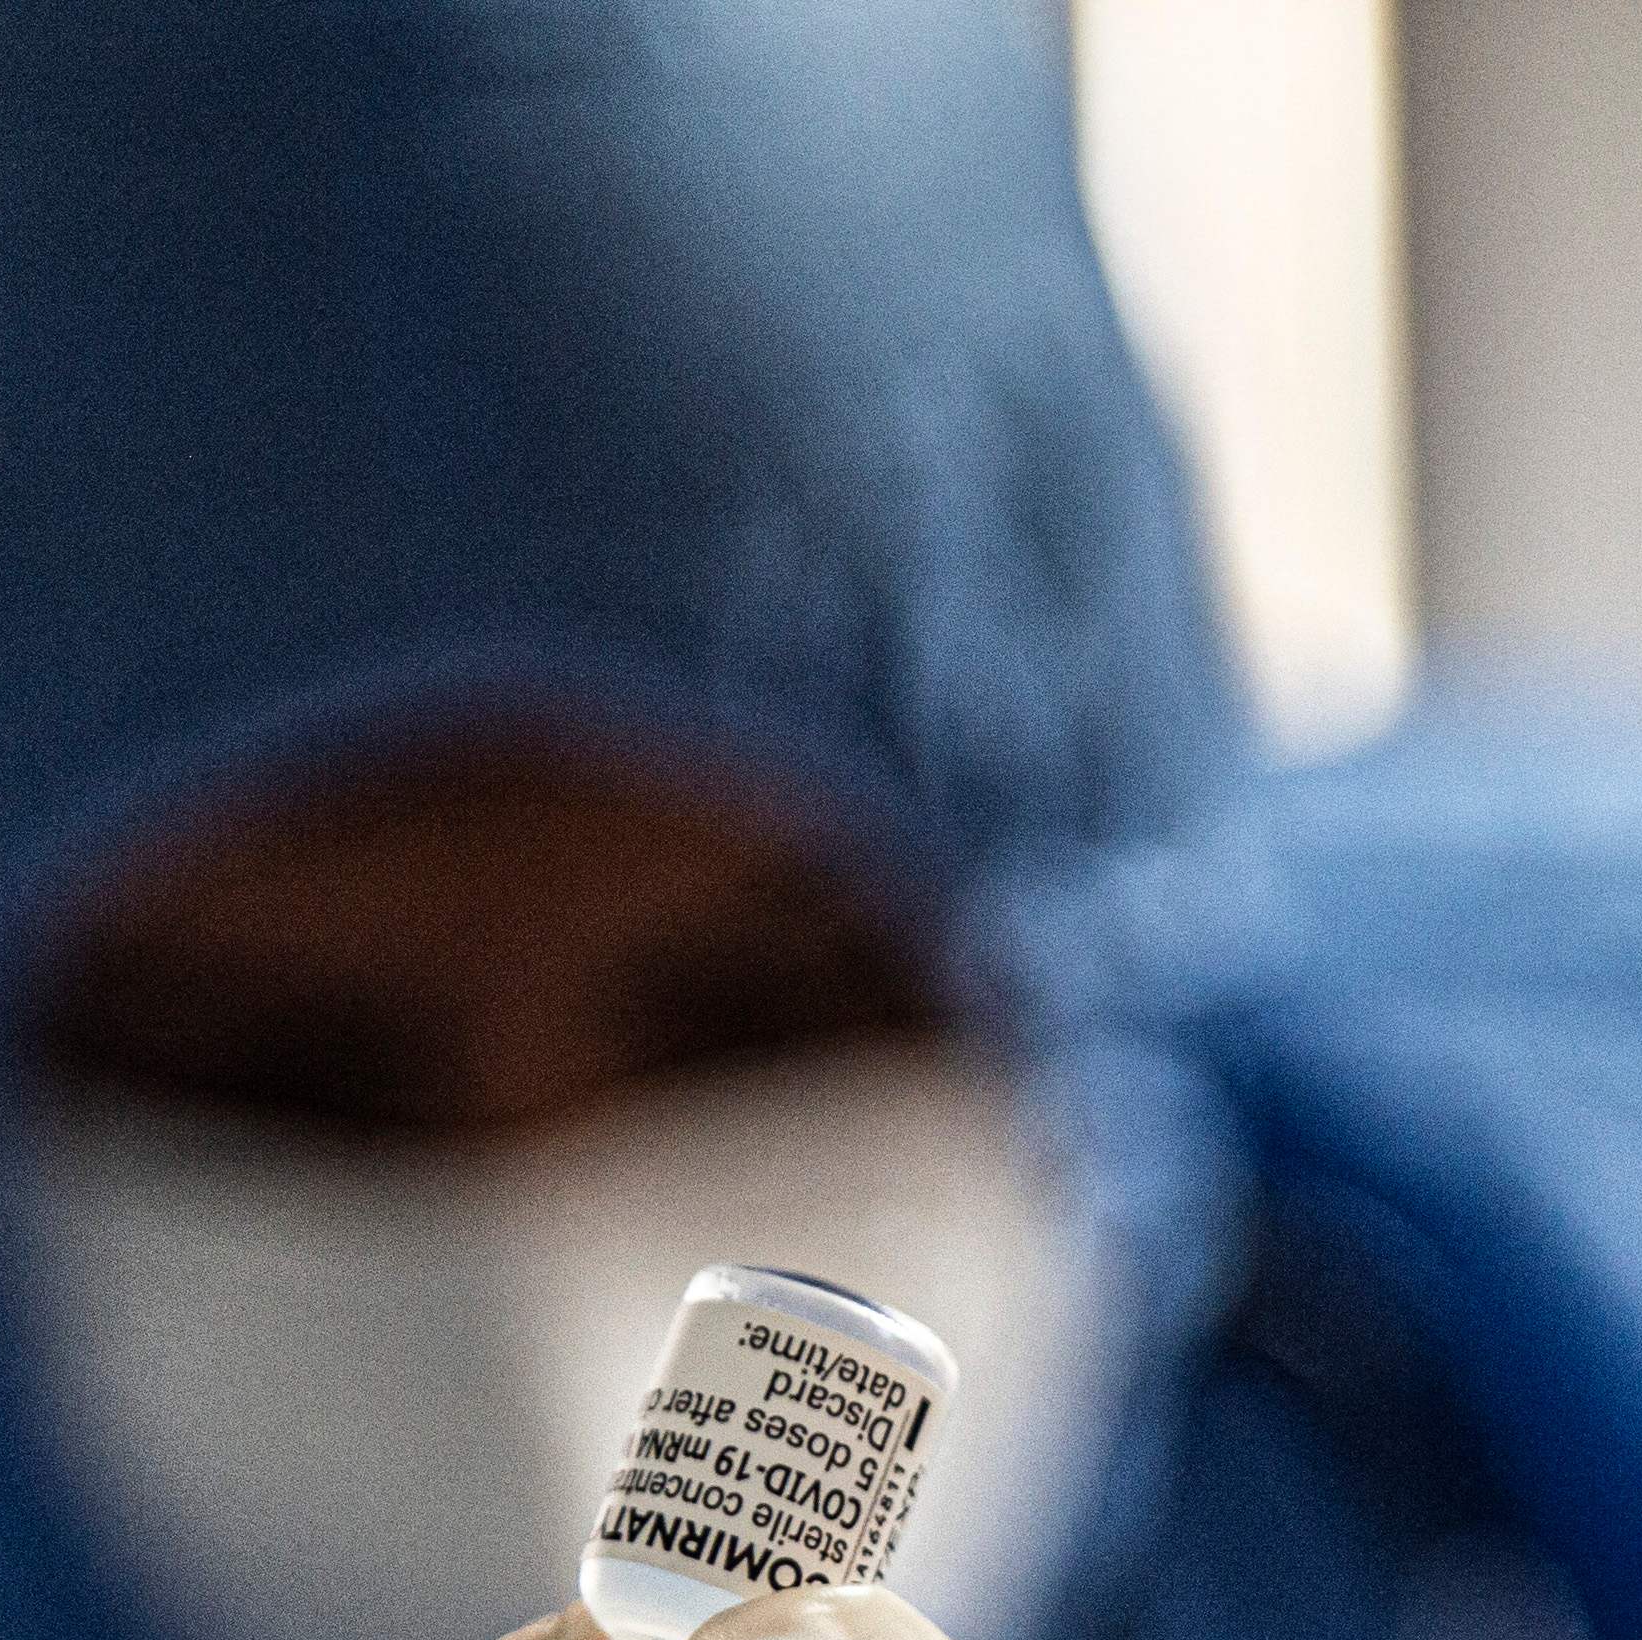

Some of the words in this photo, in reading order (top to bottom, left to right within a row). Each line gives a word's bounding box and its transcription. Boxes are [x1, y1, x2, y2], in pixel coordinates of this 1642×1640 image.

[738, 1322, 906, 1410] date/time:
[664, 1388, 736, 1425] after
[764, 1369, 894, 1451] Discard
[745, 1409, 852, 1471] doses
[715, 1446, 861, 1529] COVID-19
[856, 1458, 878, 1491] 5
[752, 1503, 847, 1563] sterile
